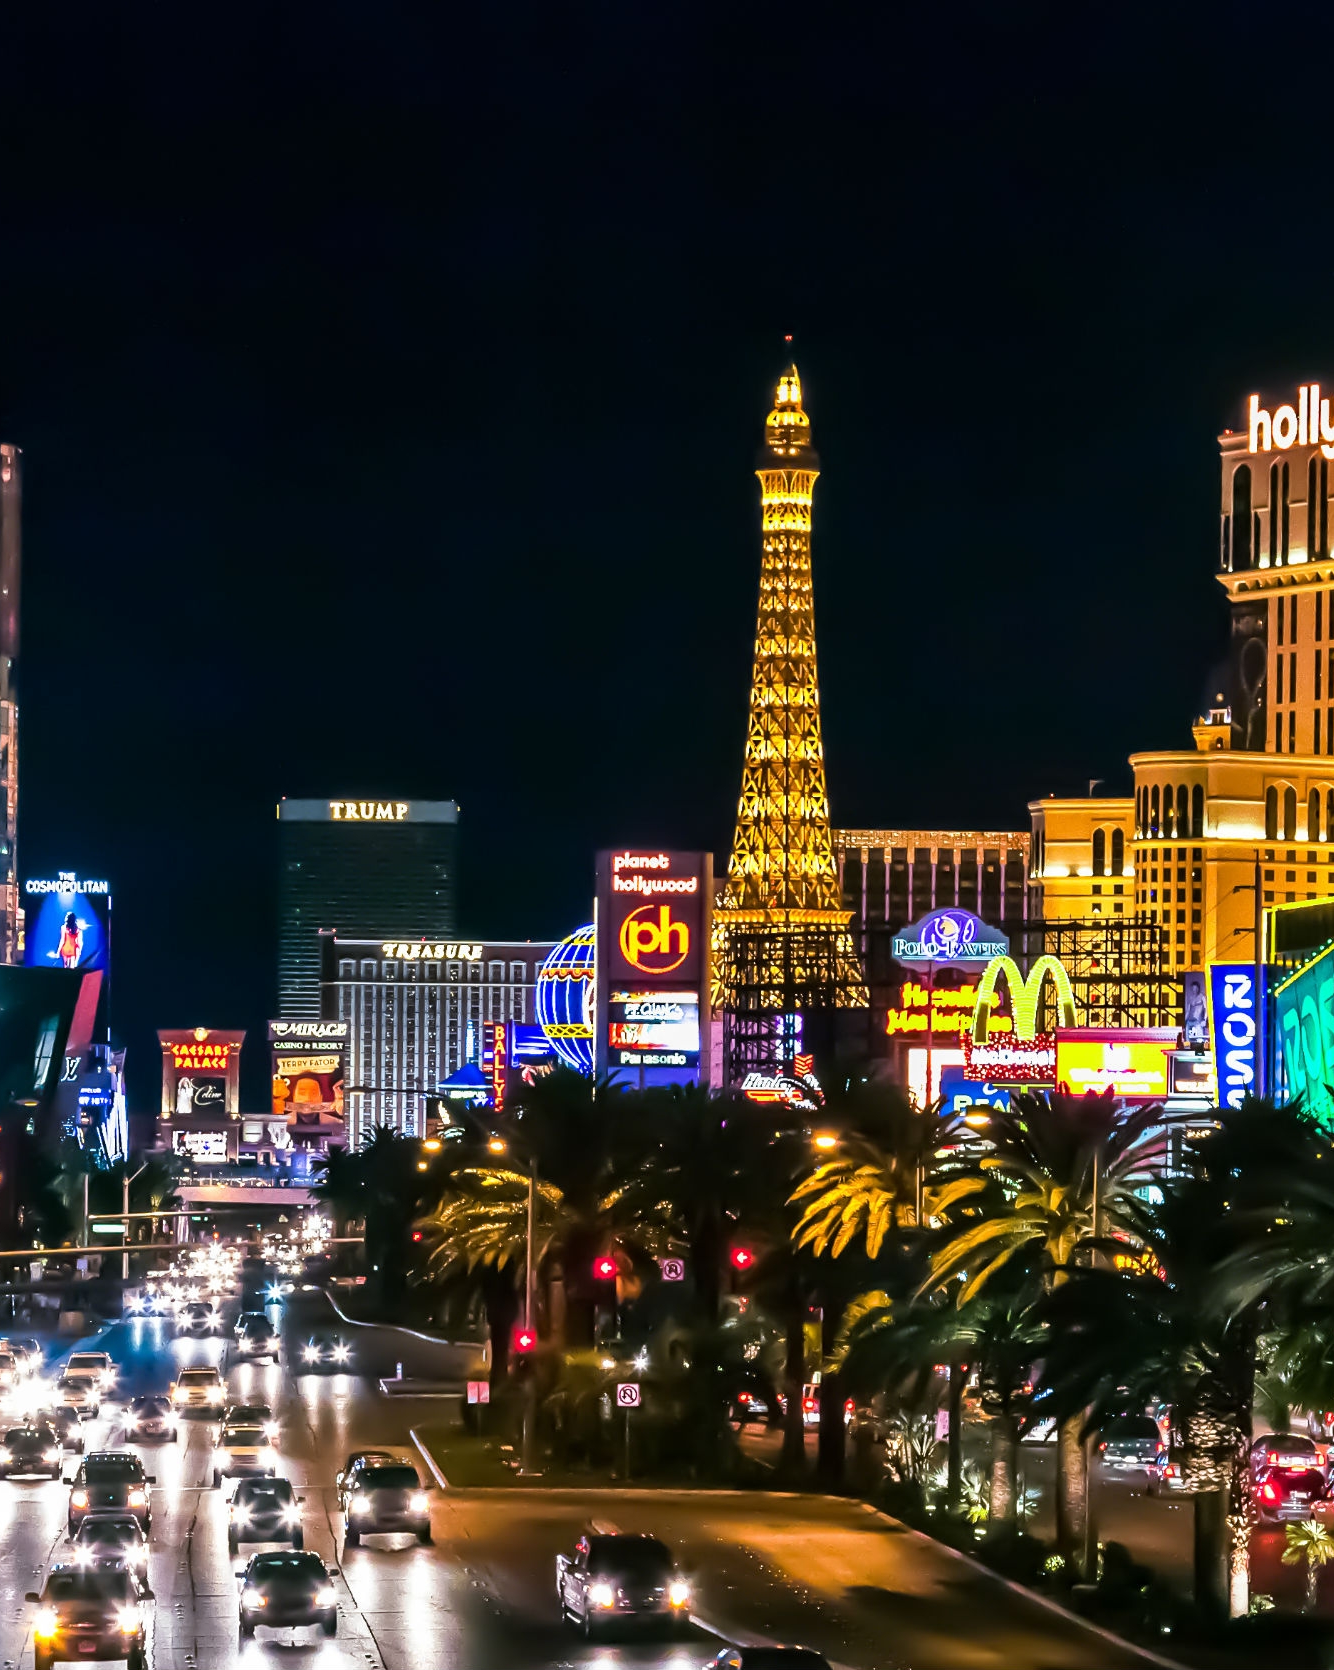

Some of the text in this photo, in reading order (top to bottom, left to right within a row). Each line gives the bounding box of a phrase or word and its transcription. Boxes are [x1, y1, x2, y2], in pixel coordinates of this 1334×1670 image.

[329, 802, 408, 821] TRUMP
[613, 852, 669, 871] planet
[25, 880, 108, 894] COSMOPOLITAN
[613, 876, 698, 895] hollywood
[627, 905, 690, 972] ph
[894, 938, 940, 957] POLO
[382, 943, 483, 961] TREASURE
[279, 1023, 347, 1037] MIRAGE
[172, 1045, 229, 1056] CAESARS
[273, 1042, 303, 1050] CASINO
[312, 1042, 344, 1050] RESORT
[175, 1057, 227, 1068] PALACE
[620, 1051, 686, 1066] Panasonic
[953, 1095, 1012, 1118] BEA
